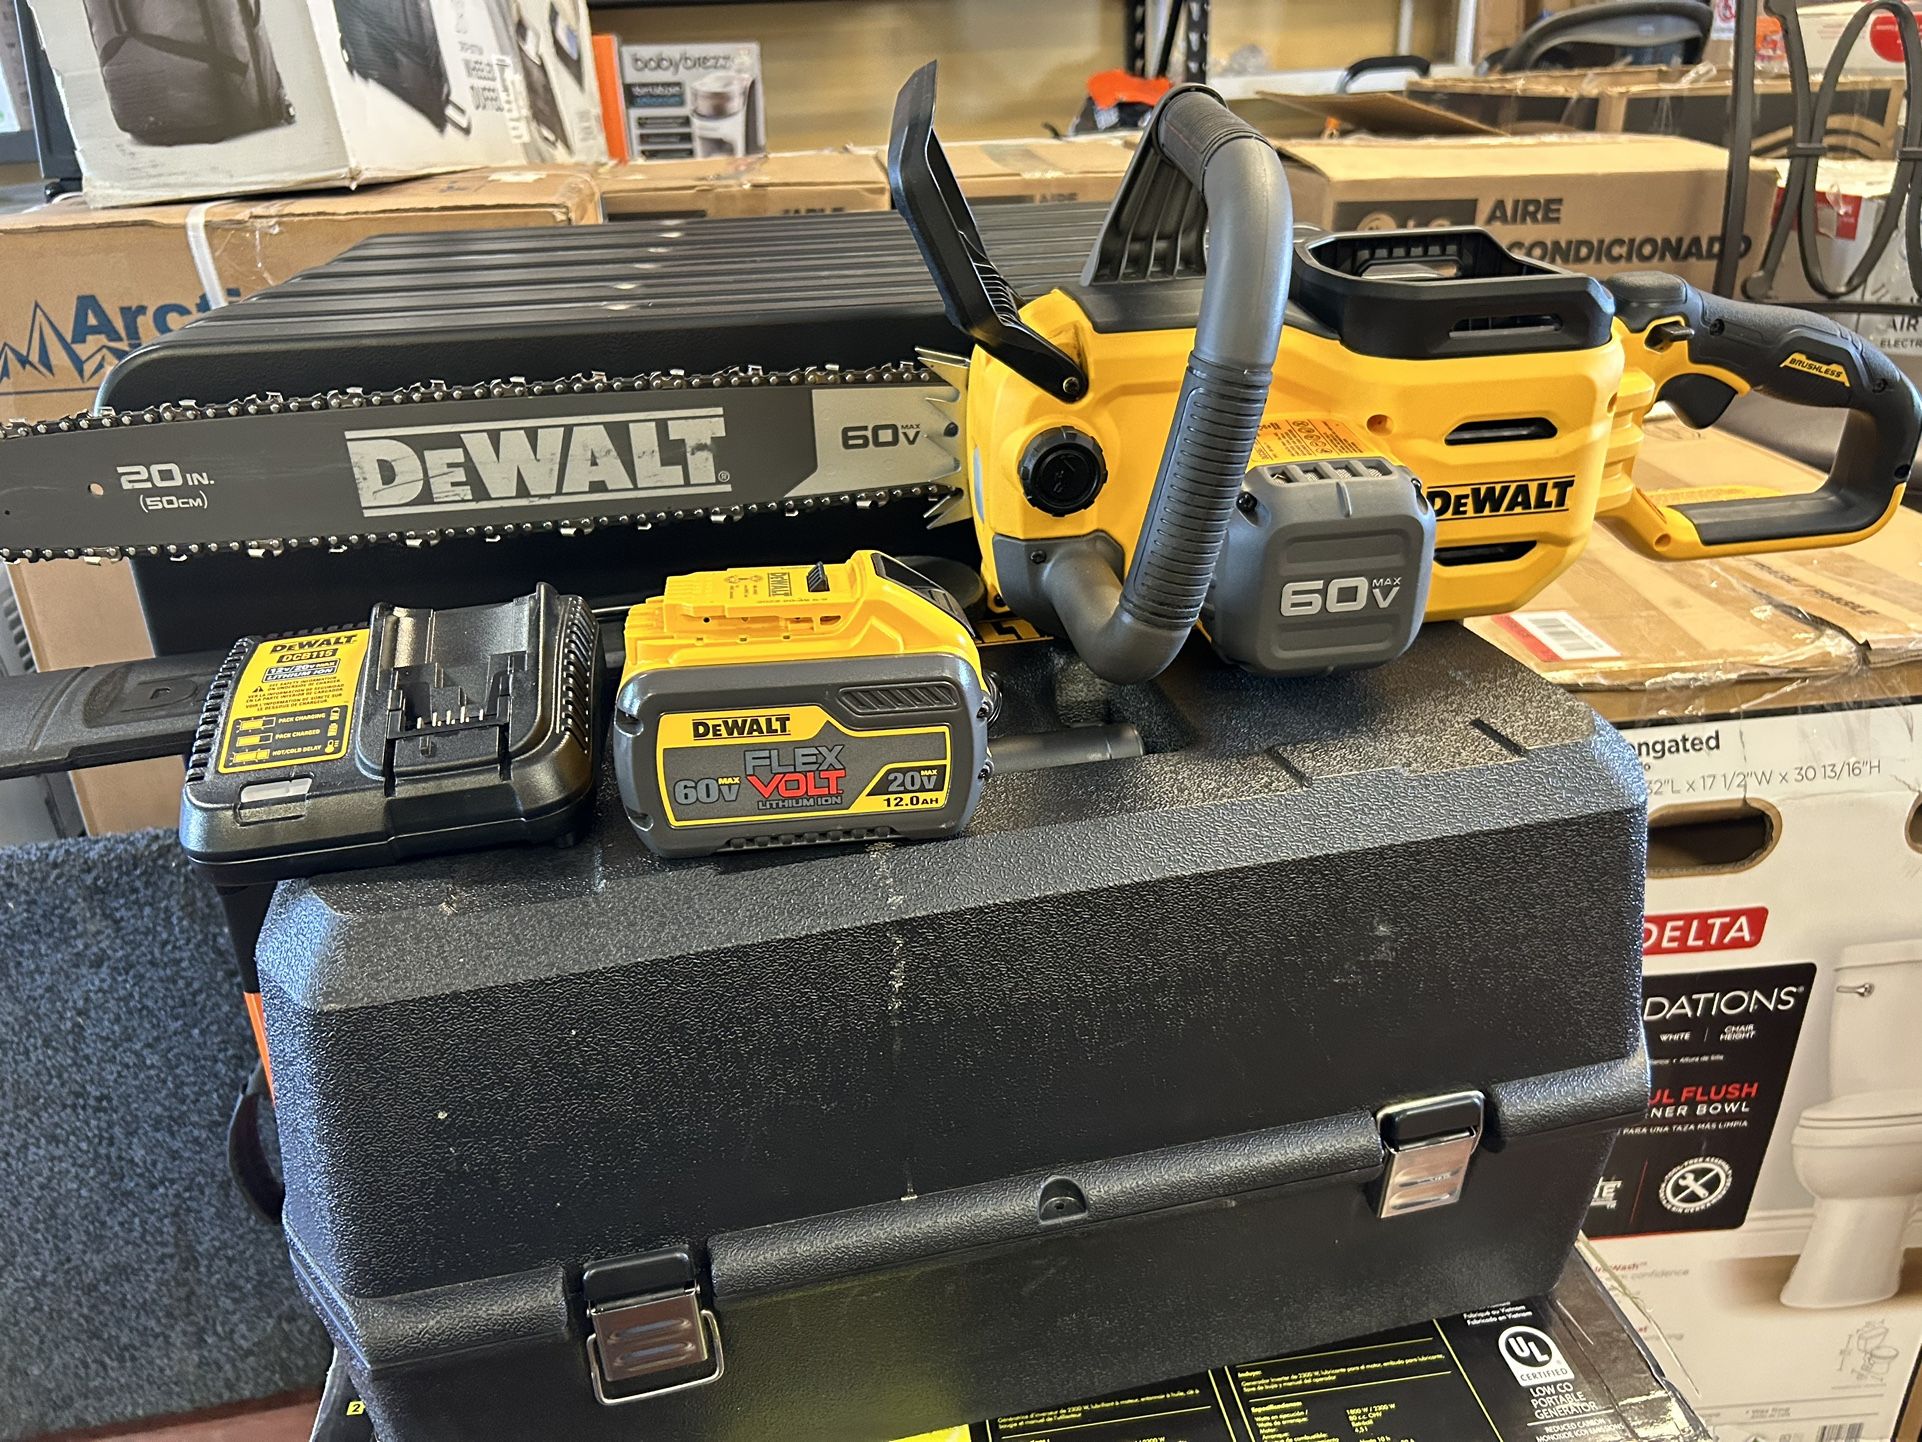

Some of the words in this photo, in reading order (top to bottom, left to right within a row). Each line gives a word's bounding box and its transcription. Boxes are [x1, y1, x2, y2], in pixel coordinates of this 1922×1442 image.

[632, 51, 738, 76] babybrezz
[1486, 198, 1563, 225] AIRE
[71, 288, 241, 350] Arc
[1788, 357, 1844, 379] BRUSHLESS
[346, 417, 727, 506] DEWALT
[116, 463, 180, 490] 20
[182, 471, 216, 486] IN.
[139, 491, 208, 515] (50CM)
[1427, 479, 1576, 518] DEWALT
[1372, 577, 1402, 587] MAX
[270, 634, 358, 654] DEWALT
[281, 650, 334, 662] DCB115
[267, 670, 311, 681] LITHIUM
[295, 713, 326, 722] CHARGING
[275, 732, 292, 740] PACK
[292, 729, 321, 738] CHARGED
[693, 717, 790, 738] DEWALT
[272, 747, 302, 757] HOT/COLD
[303, 745, 322, 753] DELAY
[744, 745, 845, 775] FLEX
[717, 776, 741, 785] MAX
[746, 769, 846, 799] VOLT
[1686, 783, 1696, 793] x
[1700, 775, 1716, 790] 17
[1779, 773, 1789, 783] x
[1795, 766, 1817, 782] 30
[1822, 759, 1881, 780] 13/16"H
[757, 798, 814, 810] LITHIUM
[816, 796, 842, 806] ION
[1643, 915, 1751, 949] DELTA
[1643, 986, 1797, 1022] DATIONS
[1659, 1032, 1691, 1042] WHITE
[1720, 1032, 1757, 1042] HEIGHT
[1725, 1024, 1755, 1033] CHAIR
[1681, 1082, 1759, 1101] FLUSH
[1645, 1104, 1688, 1119] NER
[1696, 1101, 1750, 1116] BOWL
[1650, 1126, 1669, 1134] UNA
[1673, 1124, 1695, 1132] TAZA
[1719, 1120, 1748, 1129] LIMPIA
[1508, 1336, 1550, 1363] UL
[1520, 1368, 1568, 1382] CERTIFIED
[1530, 1384, 1556, 1398] LOW
[1557, 1382, 1574, 1393] CO
[352, 1403, 361, 1413] 2
[1531, 1391, 1587, 1409] PORTABLE
[1534, 1401, 1599, 1419] GENERATOR
[1544, 1422, 1577, 1433] REDUCED
